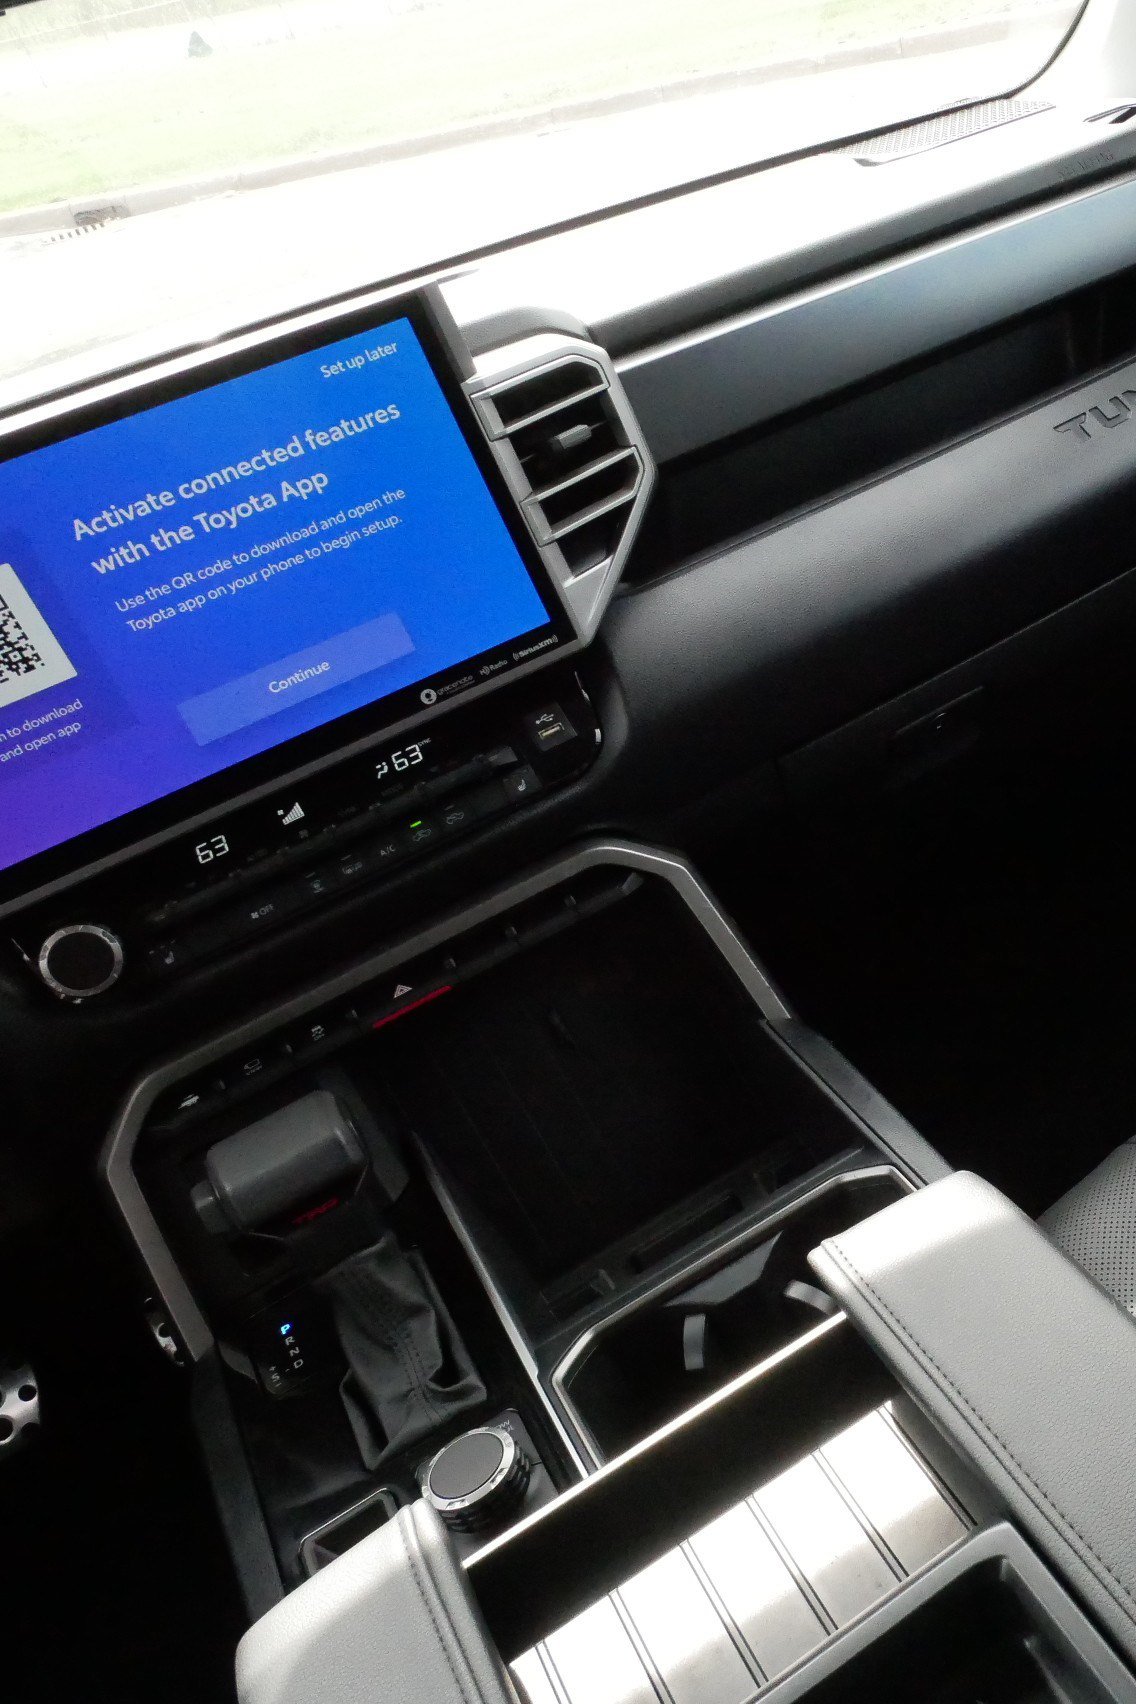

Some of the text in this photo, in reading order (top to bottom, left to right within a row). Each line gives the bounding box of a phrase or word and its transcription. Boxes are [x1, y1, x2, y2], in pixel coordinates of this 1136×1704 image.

[320, 342, 397, 378] Set up later
[72, 403, 401, 541] Activate connected features
[90, 471, 329, 575] with the Toyota App
[115, 487, 406, 612] Use the QR code to download and open the
[127, 513, 403, 633] Toyota app on your phone to begin setup.
[268, 661, 331, 693] Continue
[6, 729, 21, 738] to
[22, 698, 84, 732] download
[0, 744, 24, 762] and
[24, 732, 57, 751] open
[57, 722, 82, 738] app
[391, 744, 424, 772] 63
[195, 834, 230, 864] 63
[379, 844, 396, 857] A/C
[280, 1323, 291, 1335] P
[284, 1336, 296, 1346] R
[293, 1358, 304, 1369] D
